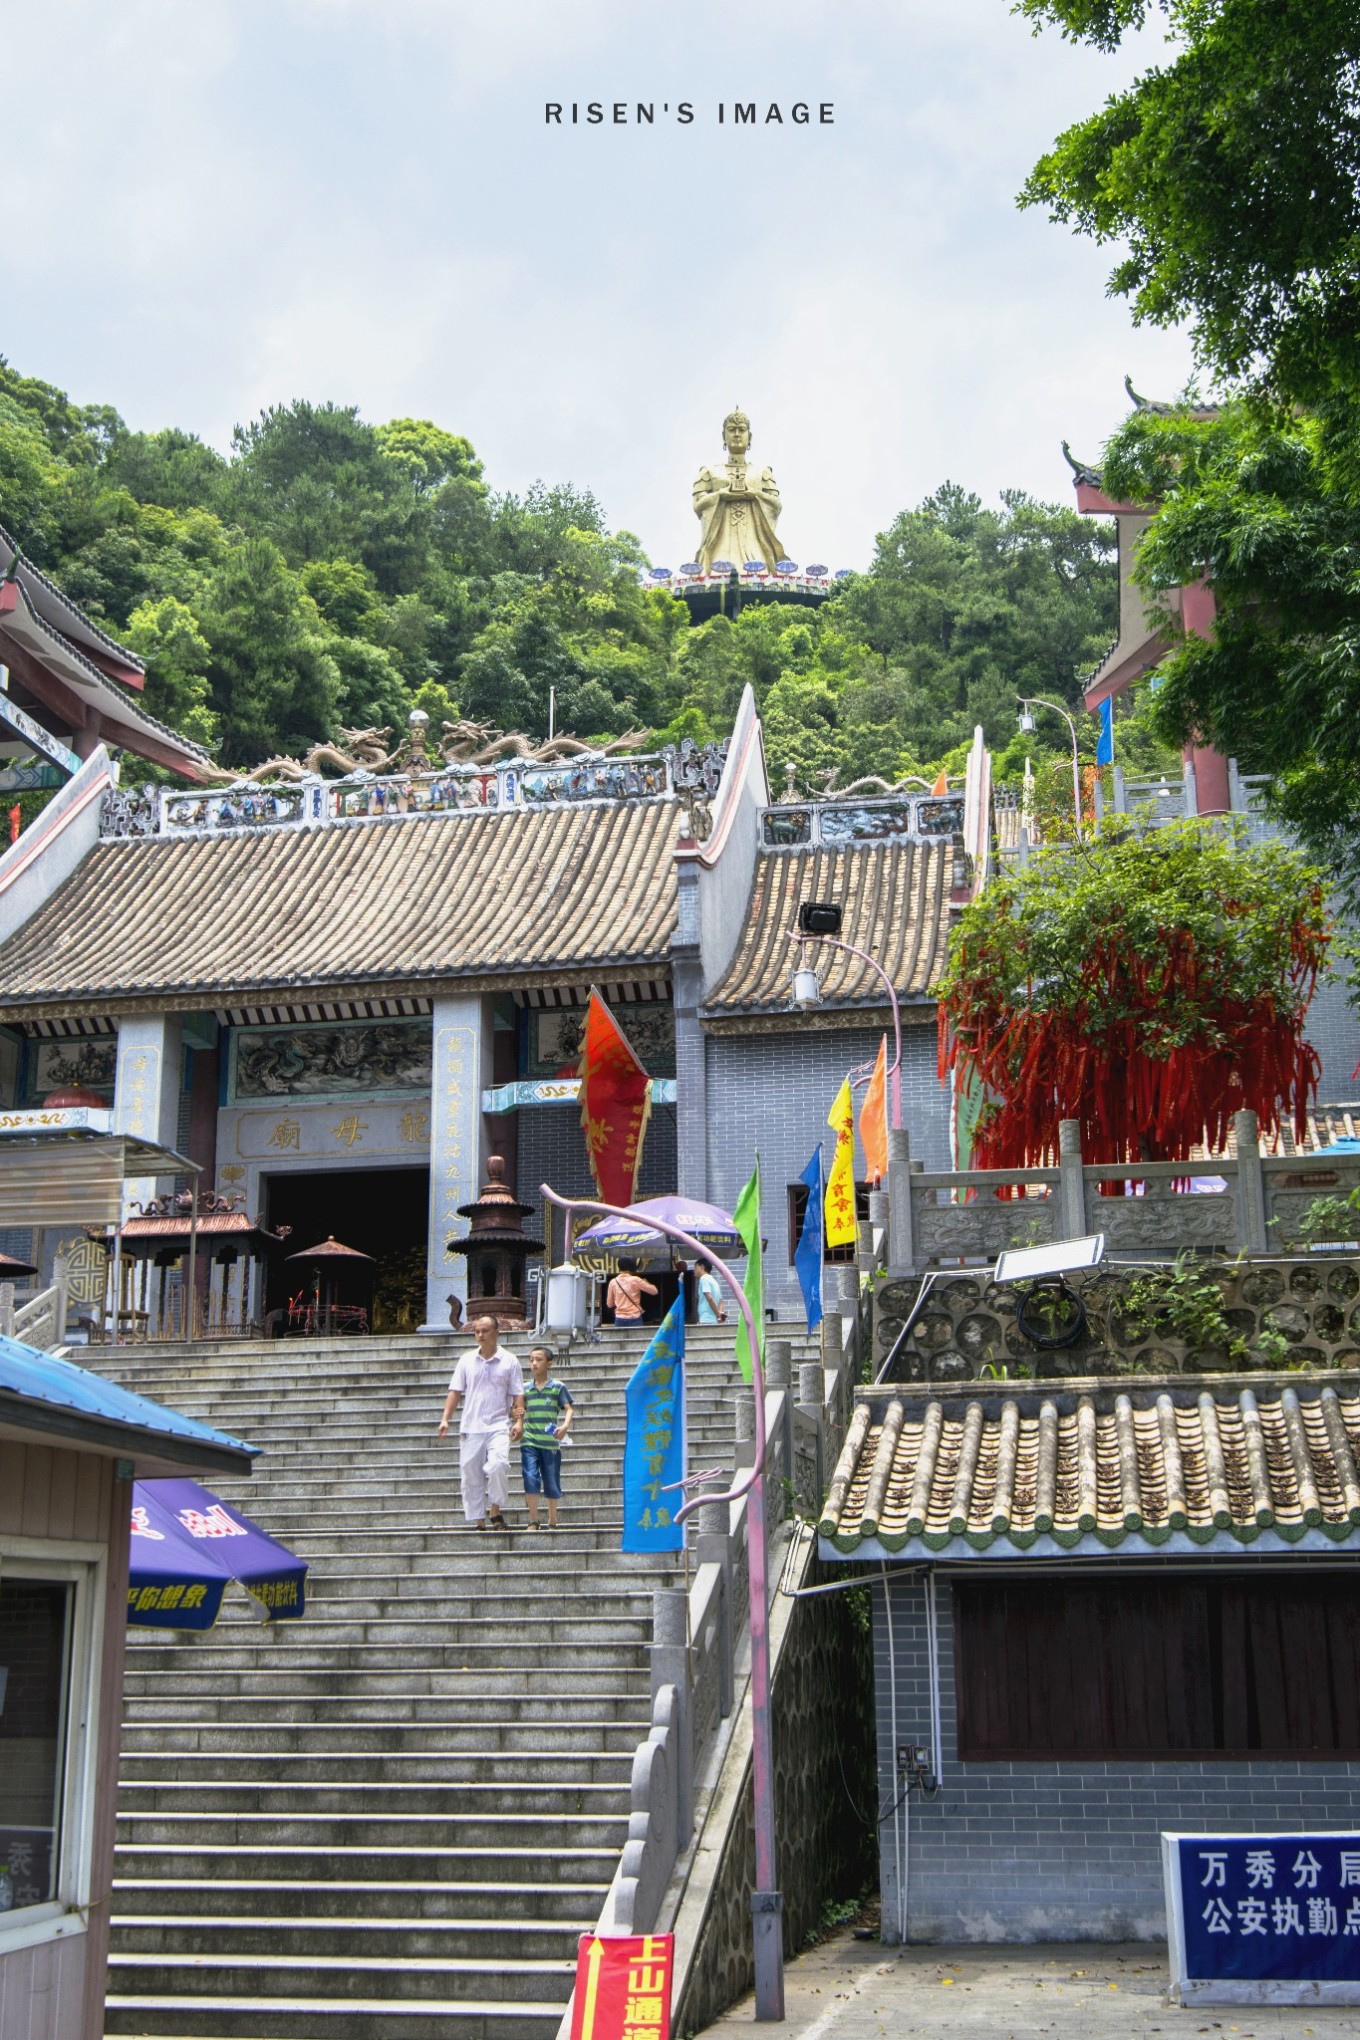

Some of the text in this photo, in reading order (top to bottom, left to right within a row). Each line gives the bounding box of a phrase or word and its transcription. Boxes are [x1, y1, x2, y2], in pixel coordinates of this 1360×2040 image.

[1198, 1850, 1360, 1889] 万秀分局
[1201, 1896, 1360, 1936] 公安执勤点
